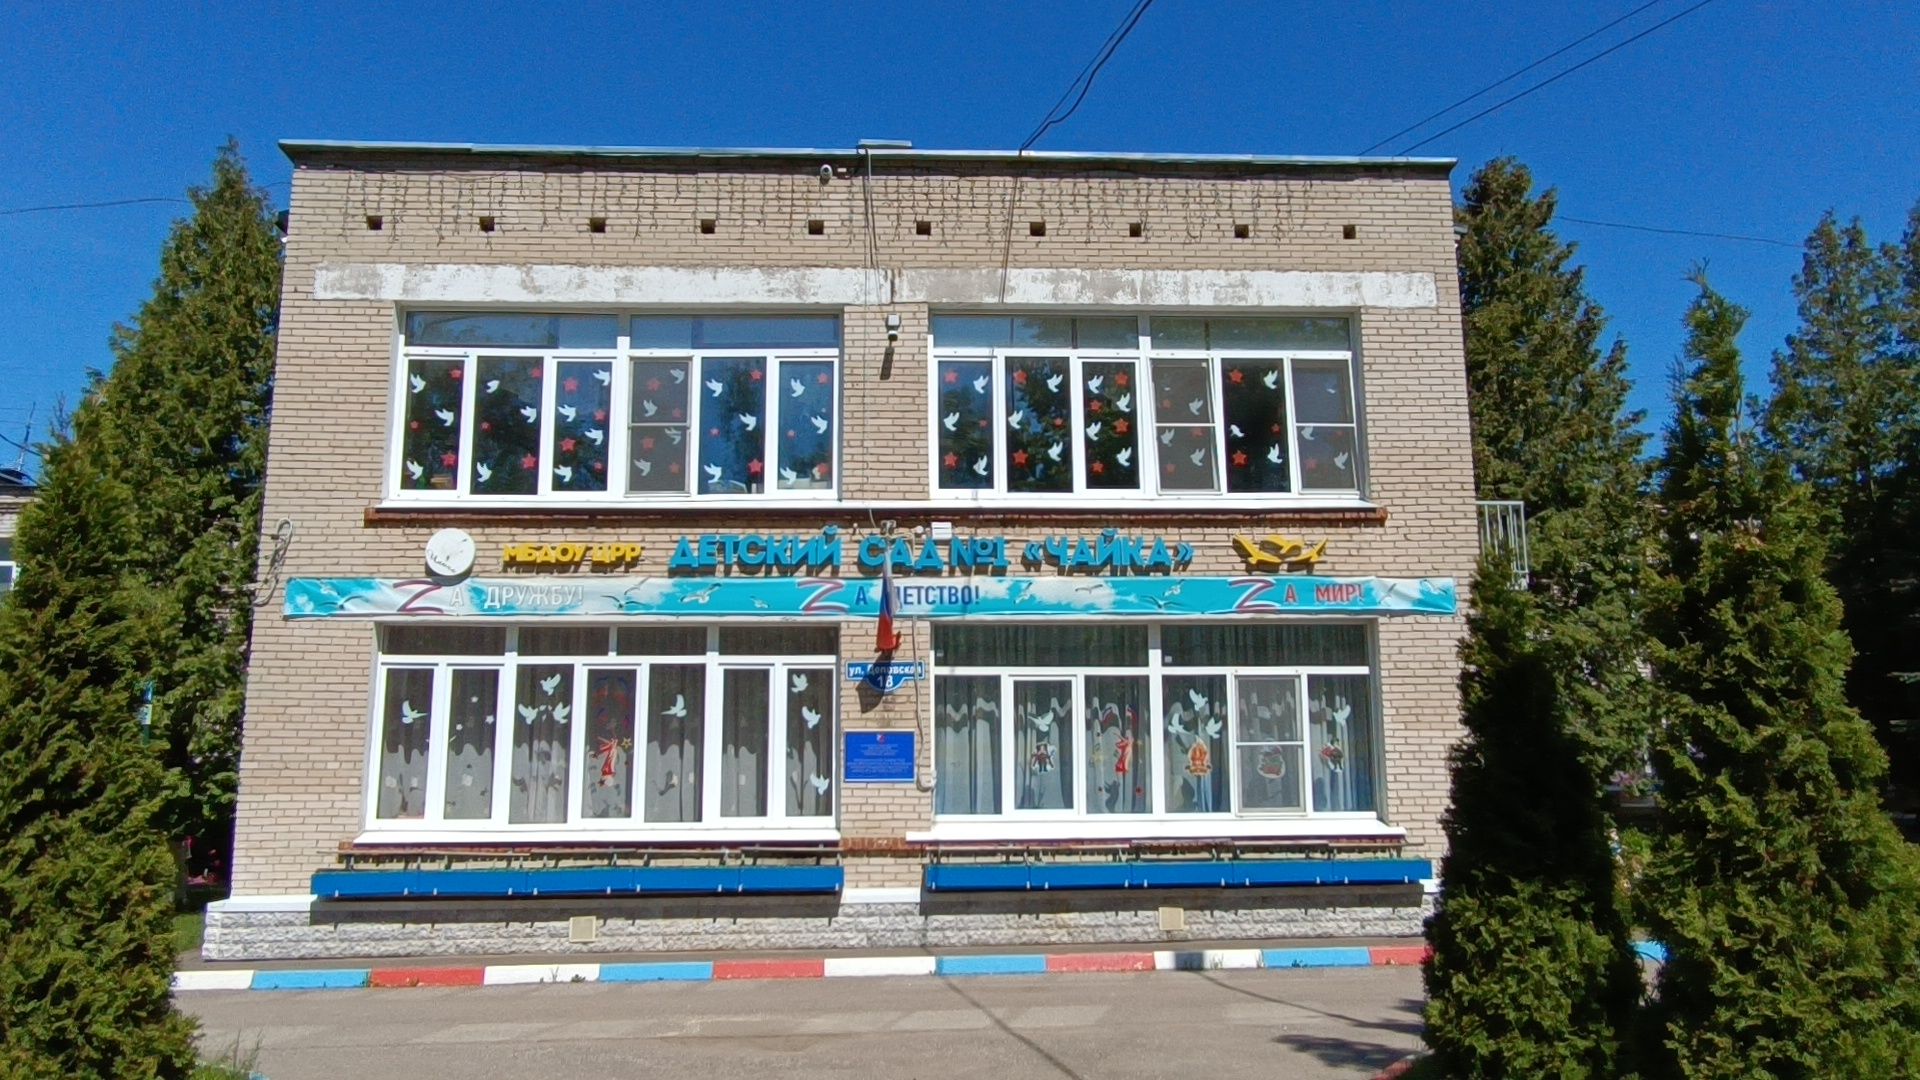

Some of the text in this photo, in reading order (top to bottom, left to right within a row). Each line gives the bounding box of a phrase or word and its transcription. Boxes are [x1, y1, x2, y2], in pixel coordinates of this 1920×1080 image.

[503, 543, 642, 563] МБДОУ ЦРР
[670, 525, 1195, 569] ДЕТСКИЙ САД №1 «ЧАЙКА»
[484, 585, 584, 609] ДРУЖБУ!
[1315, 583, 1365, 603] МИР!
[849, 666, 864, 677] ул.
